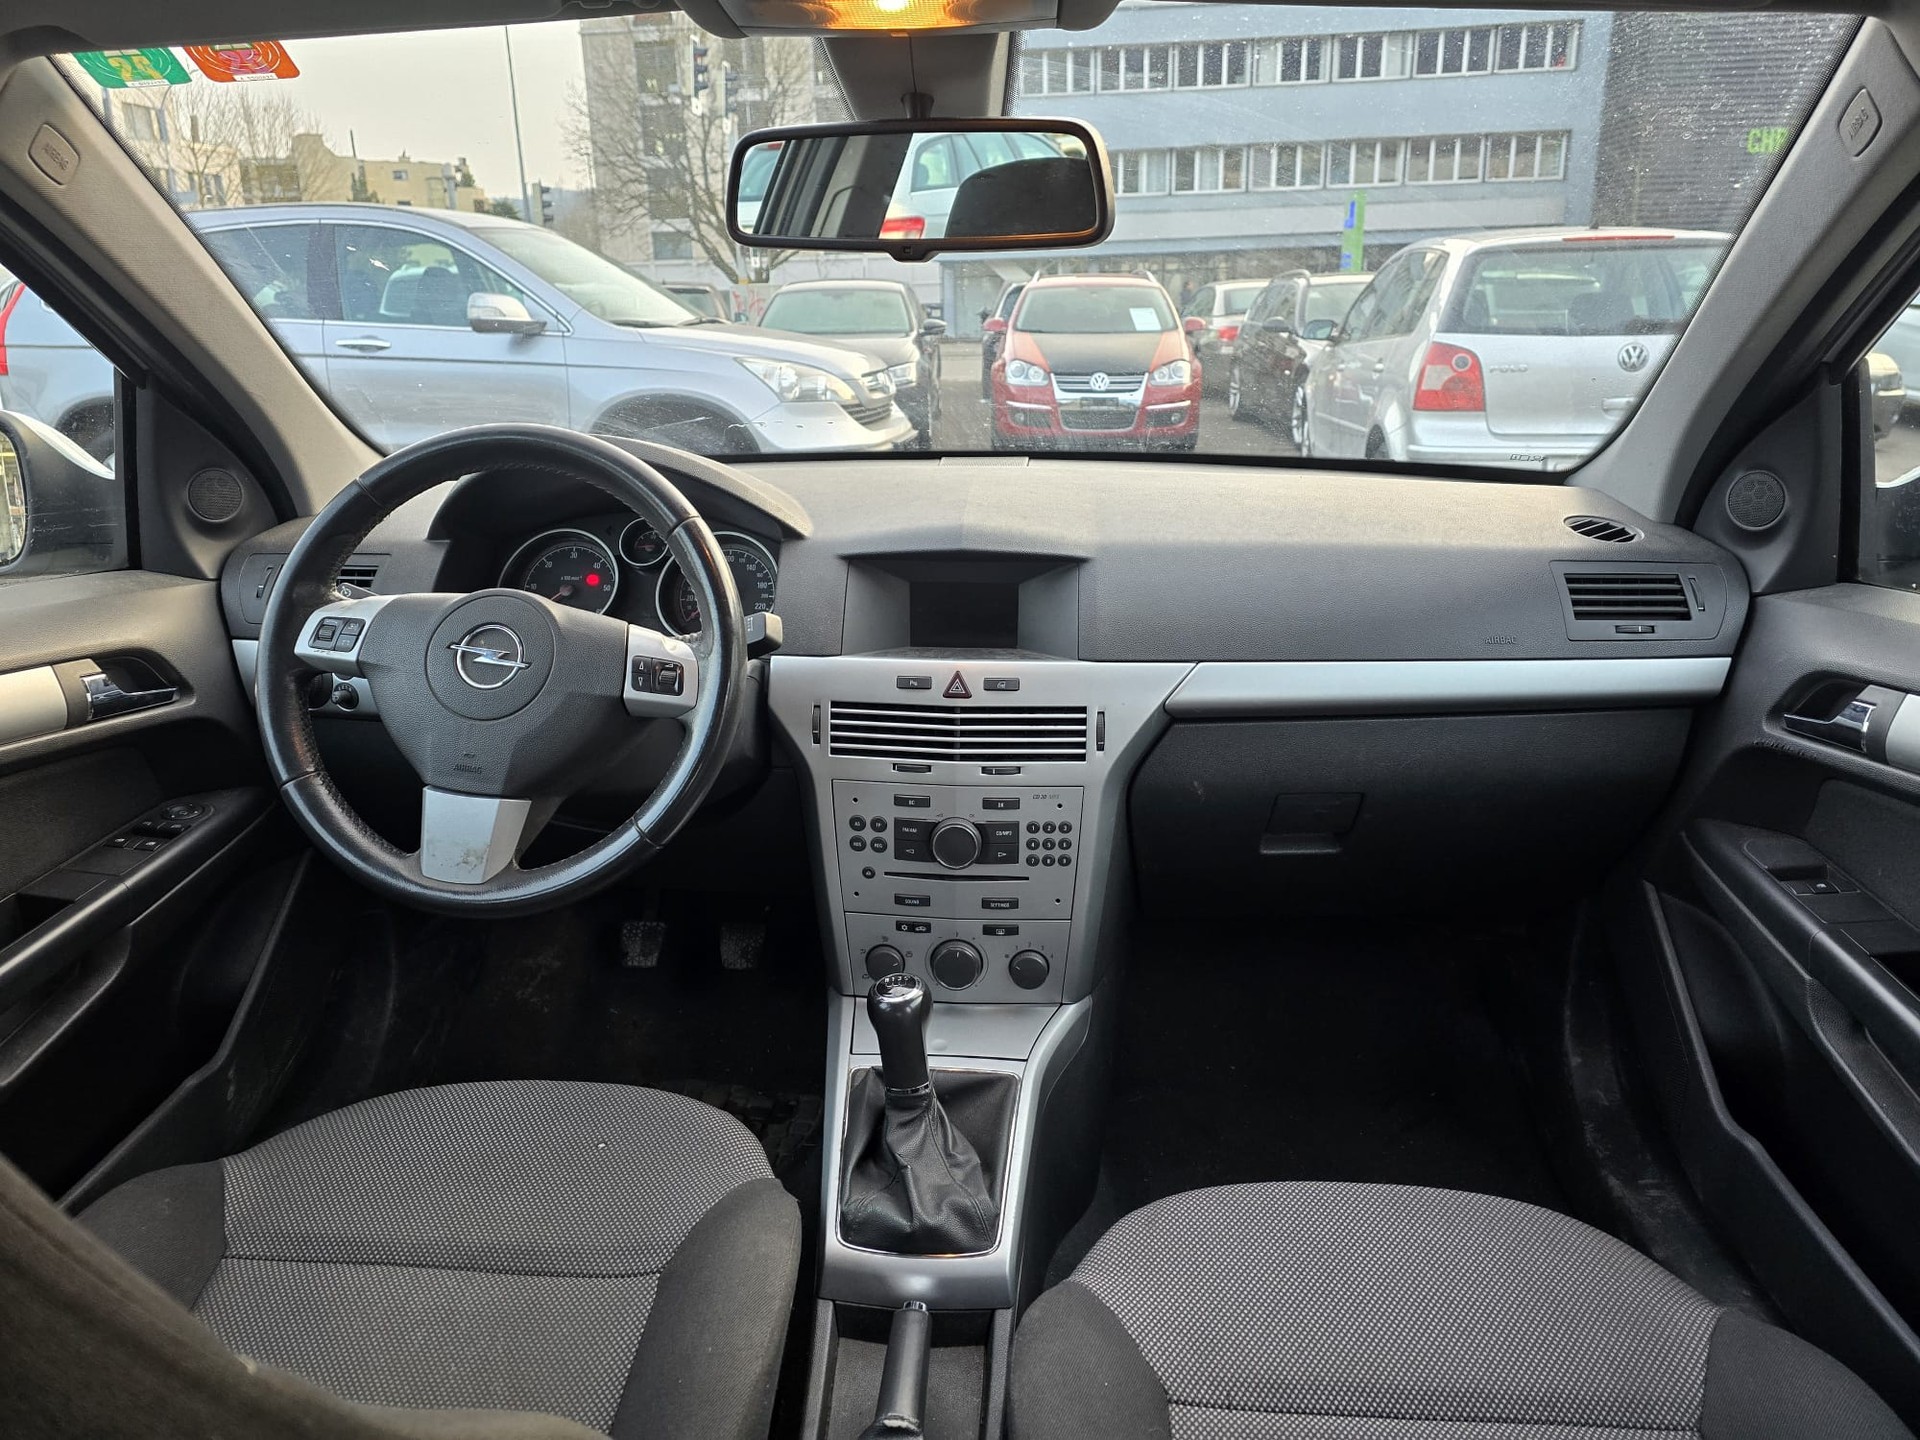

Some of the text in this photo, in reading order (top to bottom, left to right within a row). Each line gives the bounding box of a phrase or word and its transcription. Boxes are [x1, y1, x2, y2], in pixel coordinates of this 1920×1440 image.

[569, 550, 578, 559] 30
[593, 560, 601, 569] 40
[603, 584, 611, 592] 50
[754, 602, 766, 610] 220
